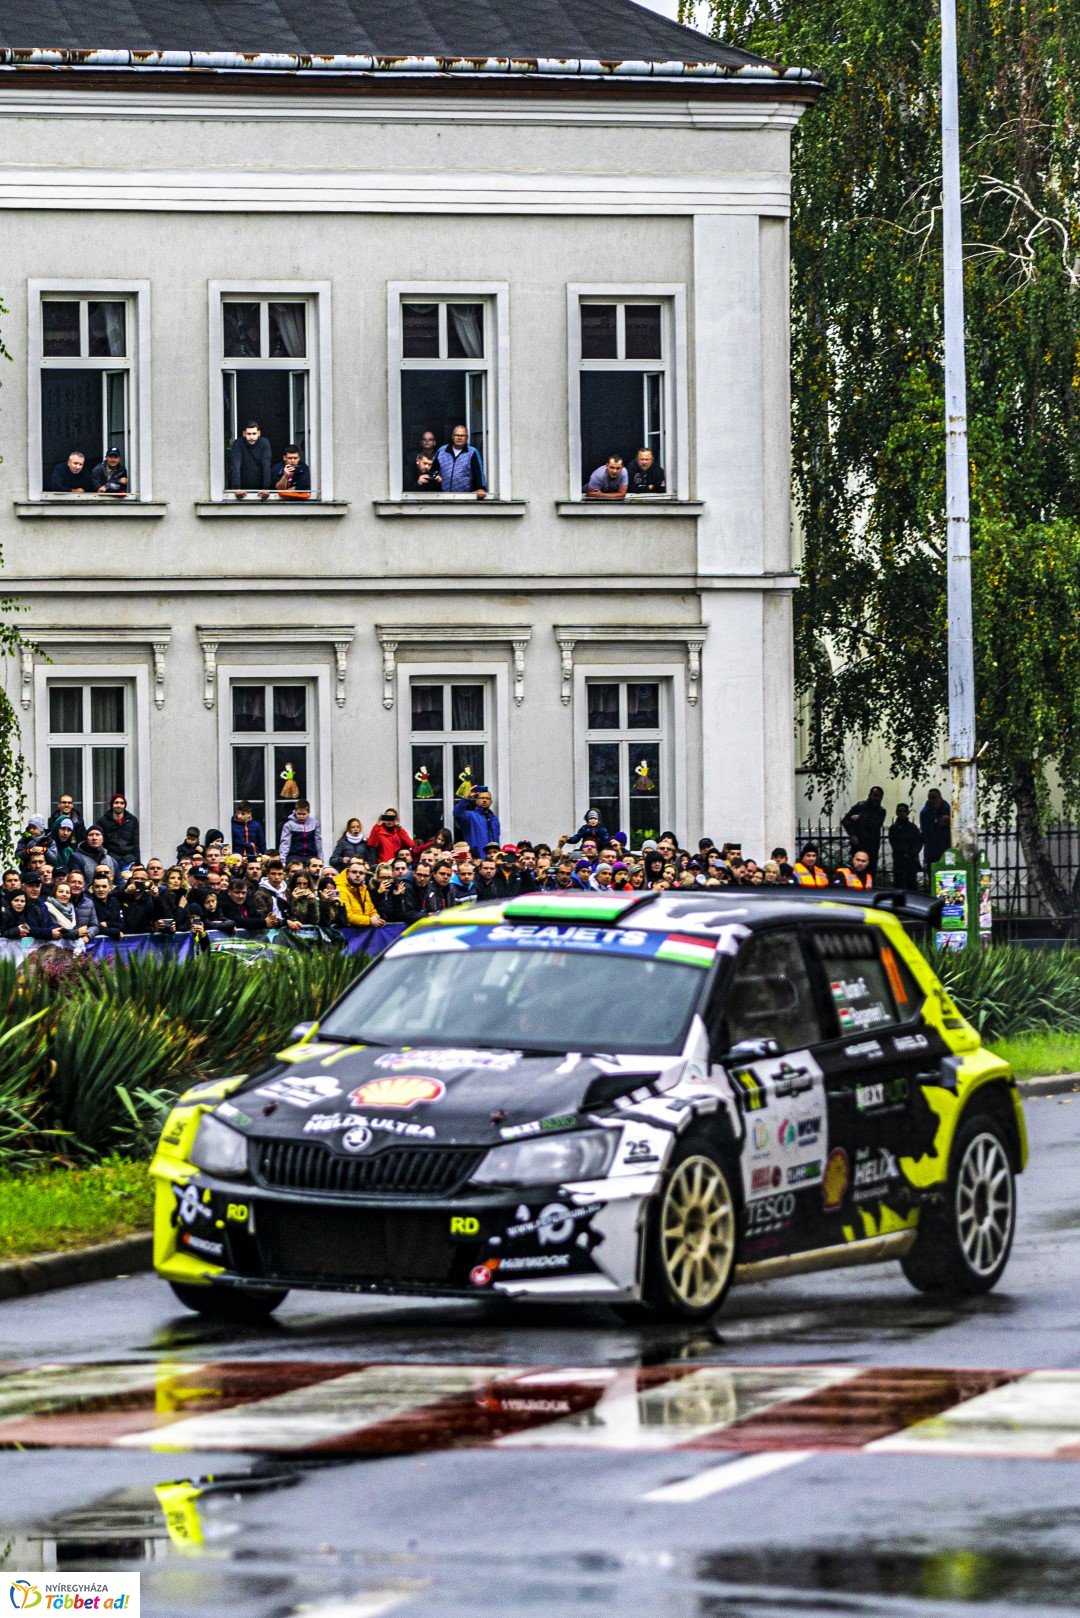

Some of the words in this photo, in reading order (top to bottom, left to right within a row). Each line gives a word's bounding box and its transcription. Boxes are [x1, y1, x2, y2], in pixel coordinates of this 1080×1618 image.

[487, 925, 648, 947] SEAJETS
[370, 1118, 436, 1139] ULTRA
[625, 1139, 651, 1156] 25
[854, 1148, 900, 1177] HELIX
[226, 1203, 249, 1222] RD
[749, 1193, 796, 1225] TESCO
[450, 1216, 480, 1235] RD
